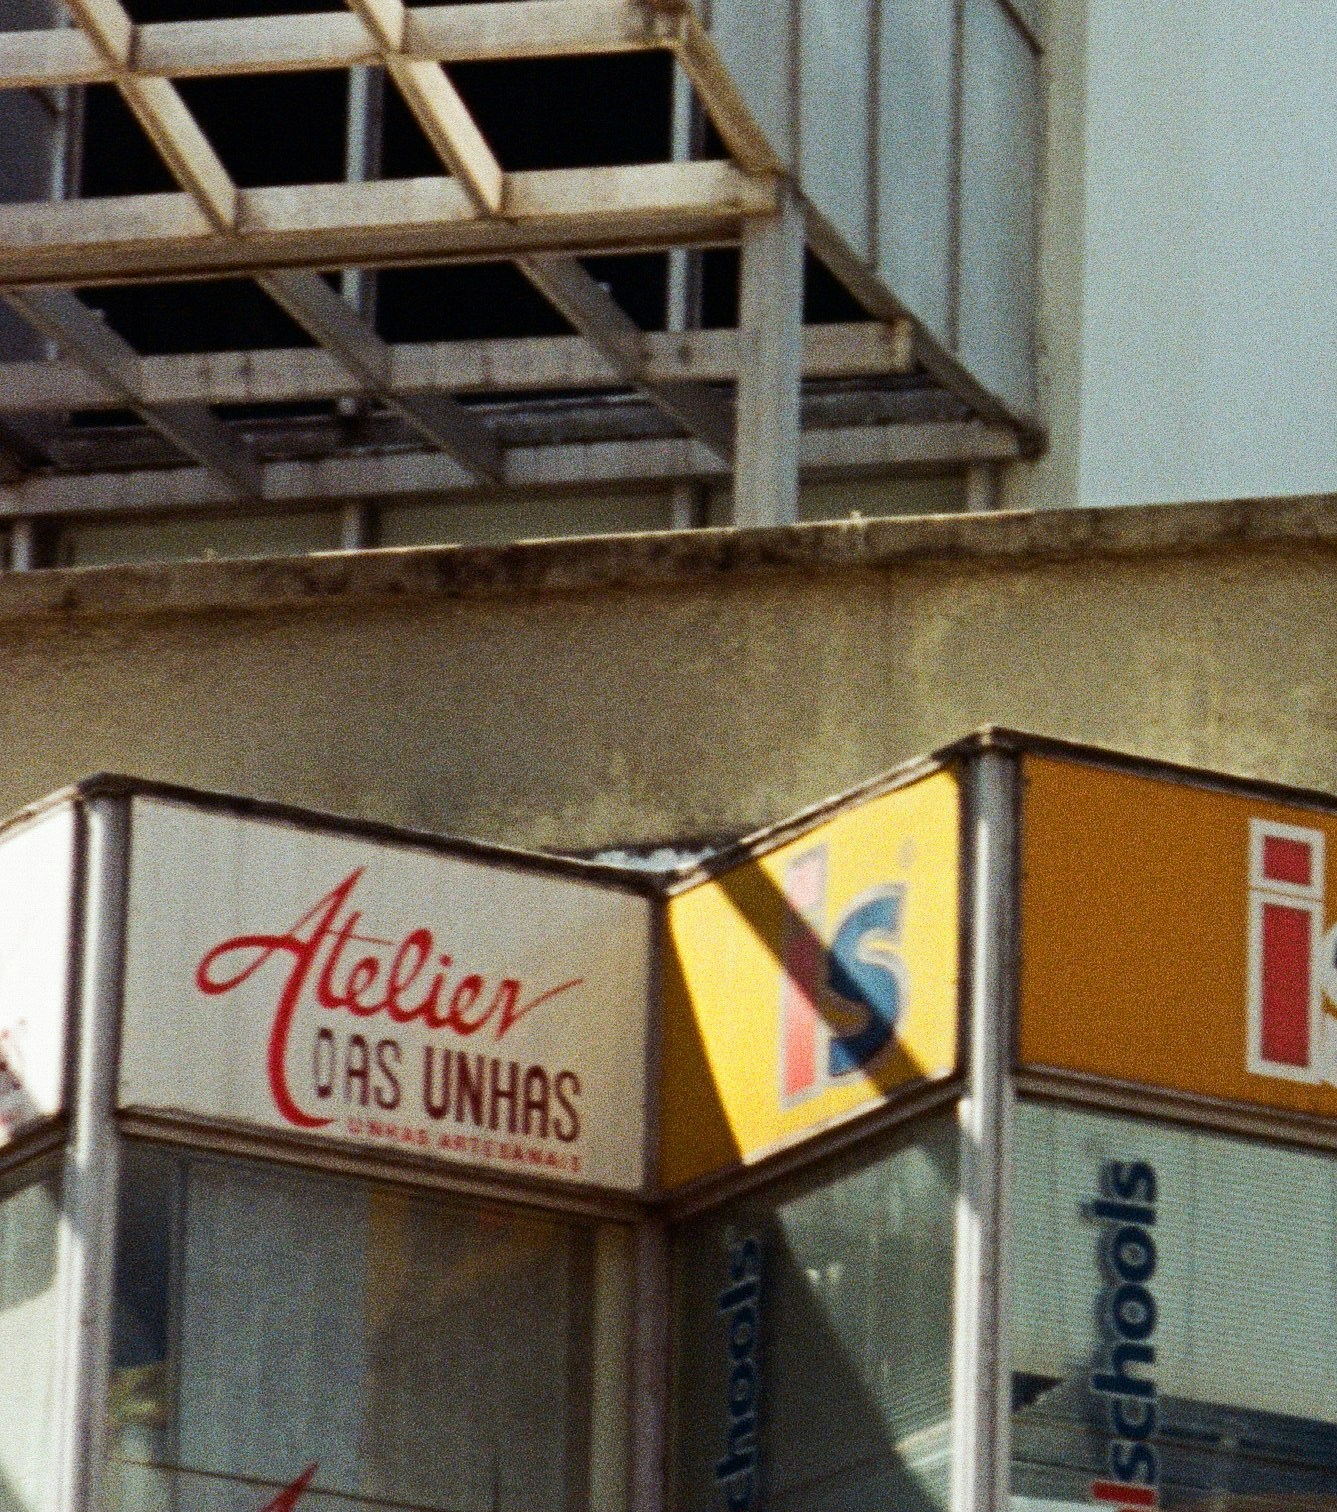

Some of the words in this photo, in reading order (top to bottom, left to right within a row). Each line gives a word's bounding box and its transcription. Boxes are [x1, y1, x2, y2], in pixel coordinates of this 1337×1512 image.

[195, 865, 584, 1128] Atelier
[312, 1027, 401, 1111] DAS
[425, 1047, 583, 1143] UNHAS
